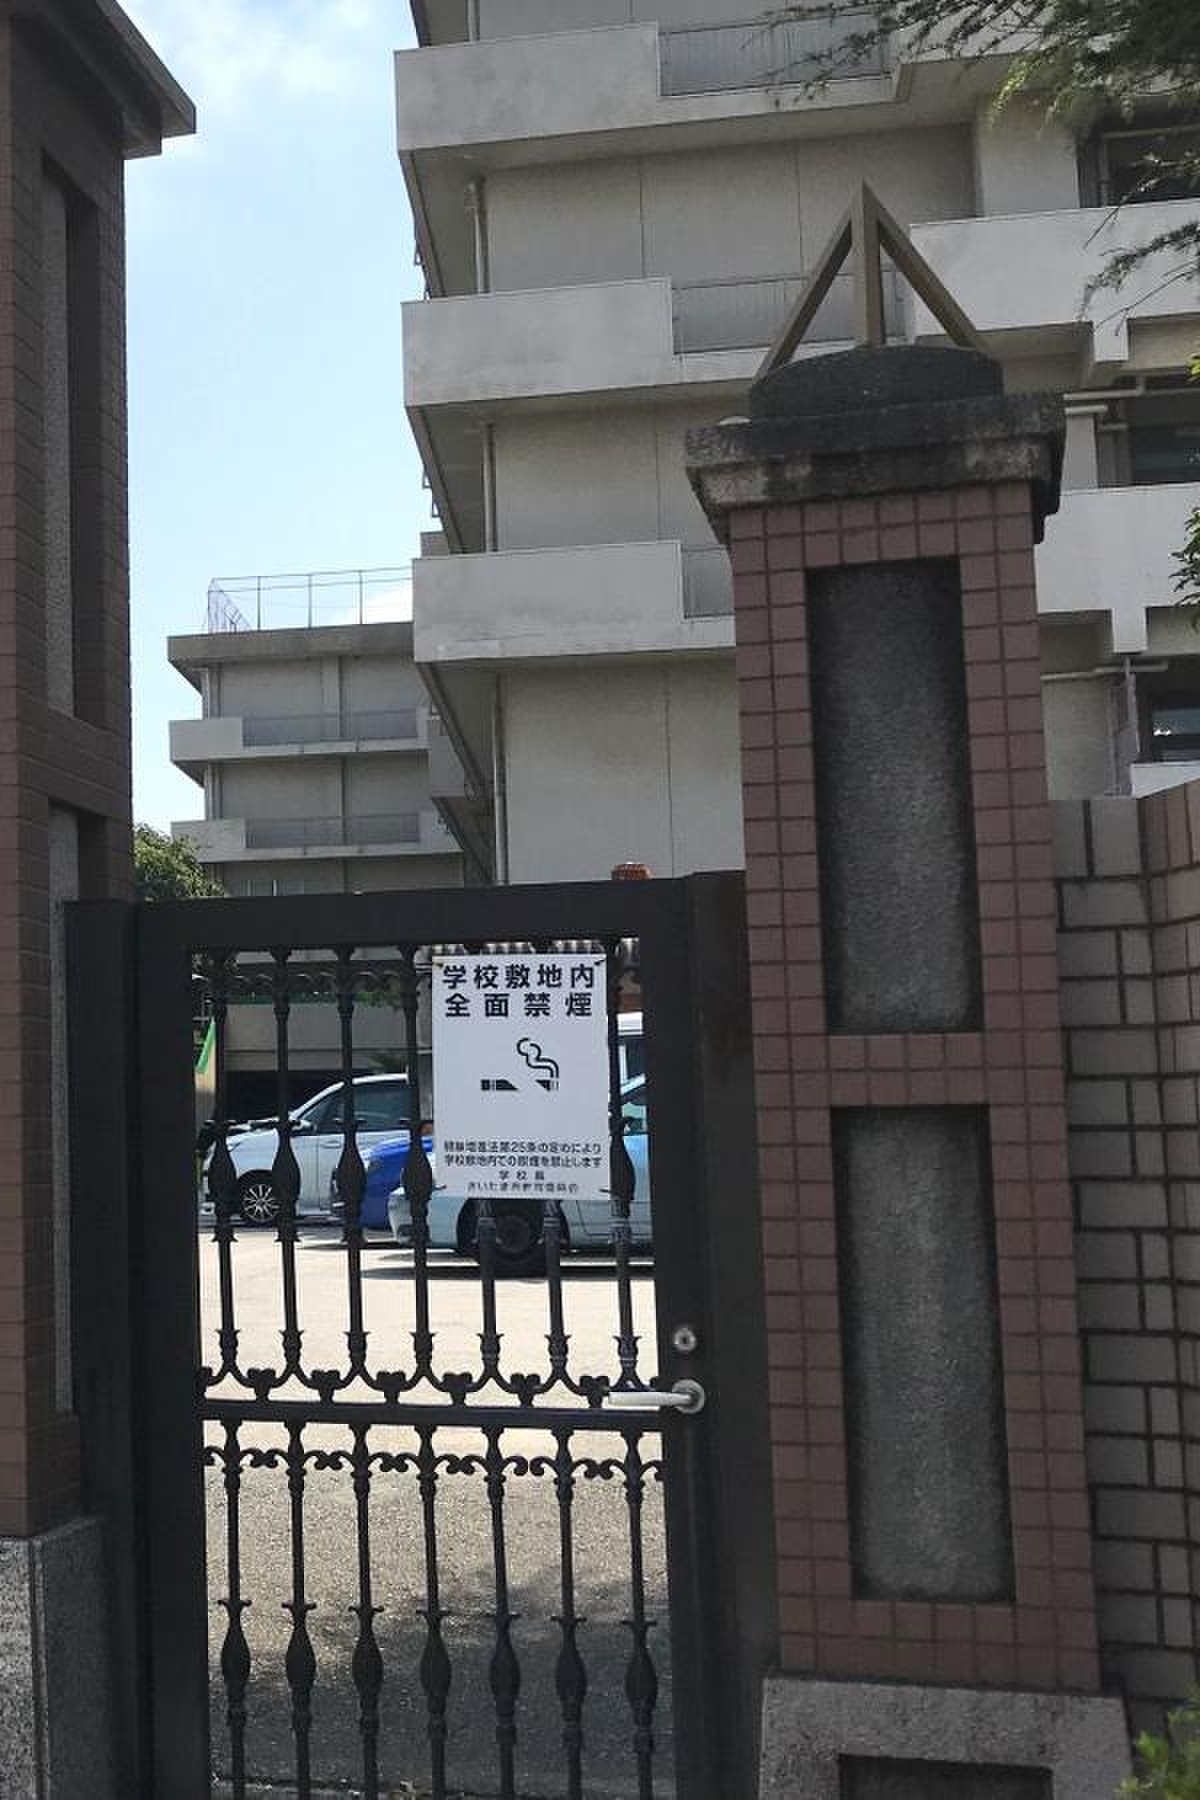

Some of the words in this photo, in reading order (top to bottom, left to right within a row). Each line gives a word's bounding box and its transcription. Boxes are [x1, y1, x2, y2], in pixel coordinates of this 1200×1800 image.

[442, 964, 595, 989] 学校敷地内
[445, 992, 593, 1018] 全面禁煙
